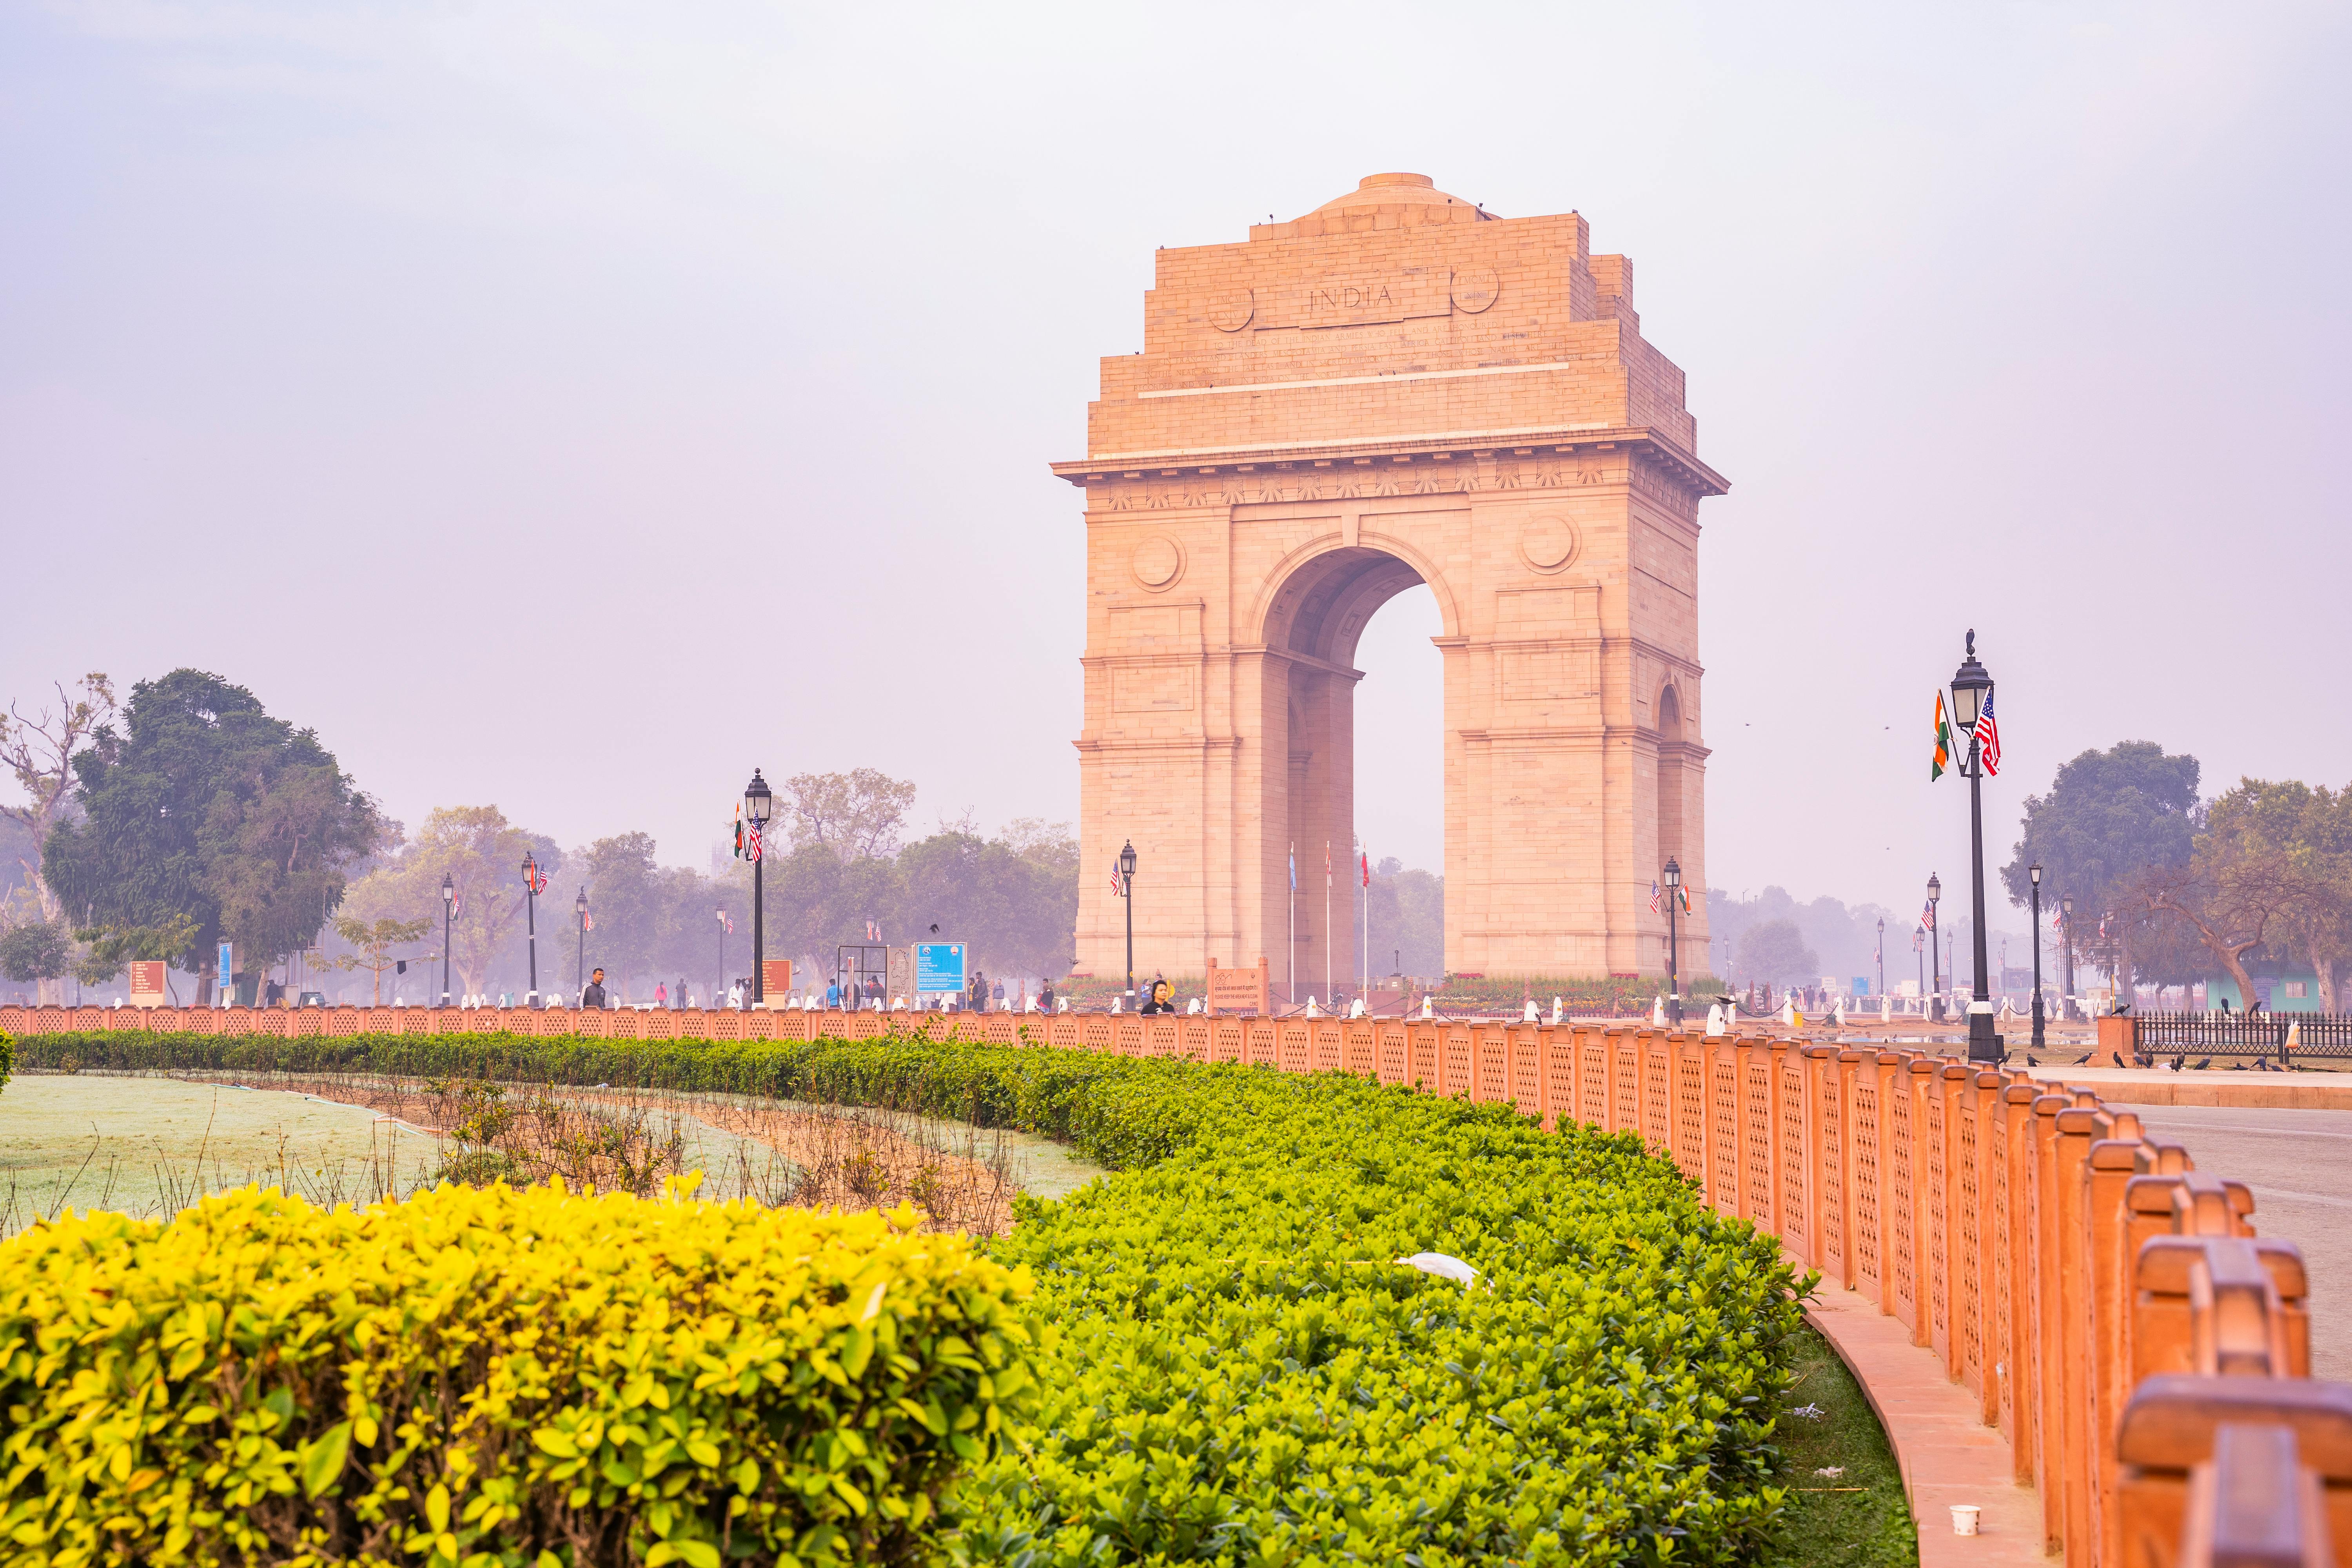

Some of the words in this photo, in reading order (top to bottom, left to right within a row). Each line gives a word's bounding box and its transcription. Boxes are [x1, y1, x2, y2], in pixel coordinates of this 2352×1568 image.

[1309, 285, 1393, 310] INDIA
[1304, 334, 1330, 343] INDIAN
[1336, 332, 1363, 340] ARMIES
[1453, 321, 1497, 330] HONOURED
[1231, 351, 1267, 359] FLANDERS
[1274, 347, 1325, 357] MESOPOTAMIA
[1402, 339, 1429, 347] AFRICA
[1435, 336, 1474, 345] GALLIPOLI
[1503, 331, 1547, 340] ELSEWHERE
[1459, 347, 1484, 356] WHOSE
[1134, 382, 1173, 391] RECORDED
[1371, 366, 1408, 375] FRONTIER
[1437, 362, 1468, 370] DURING
